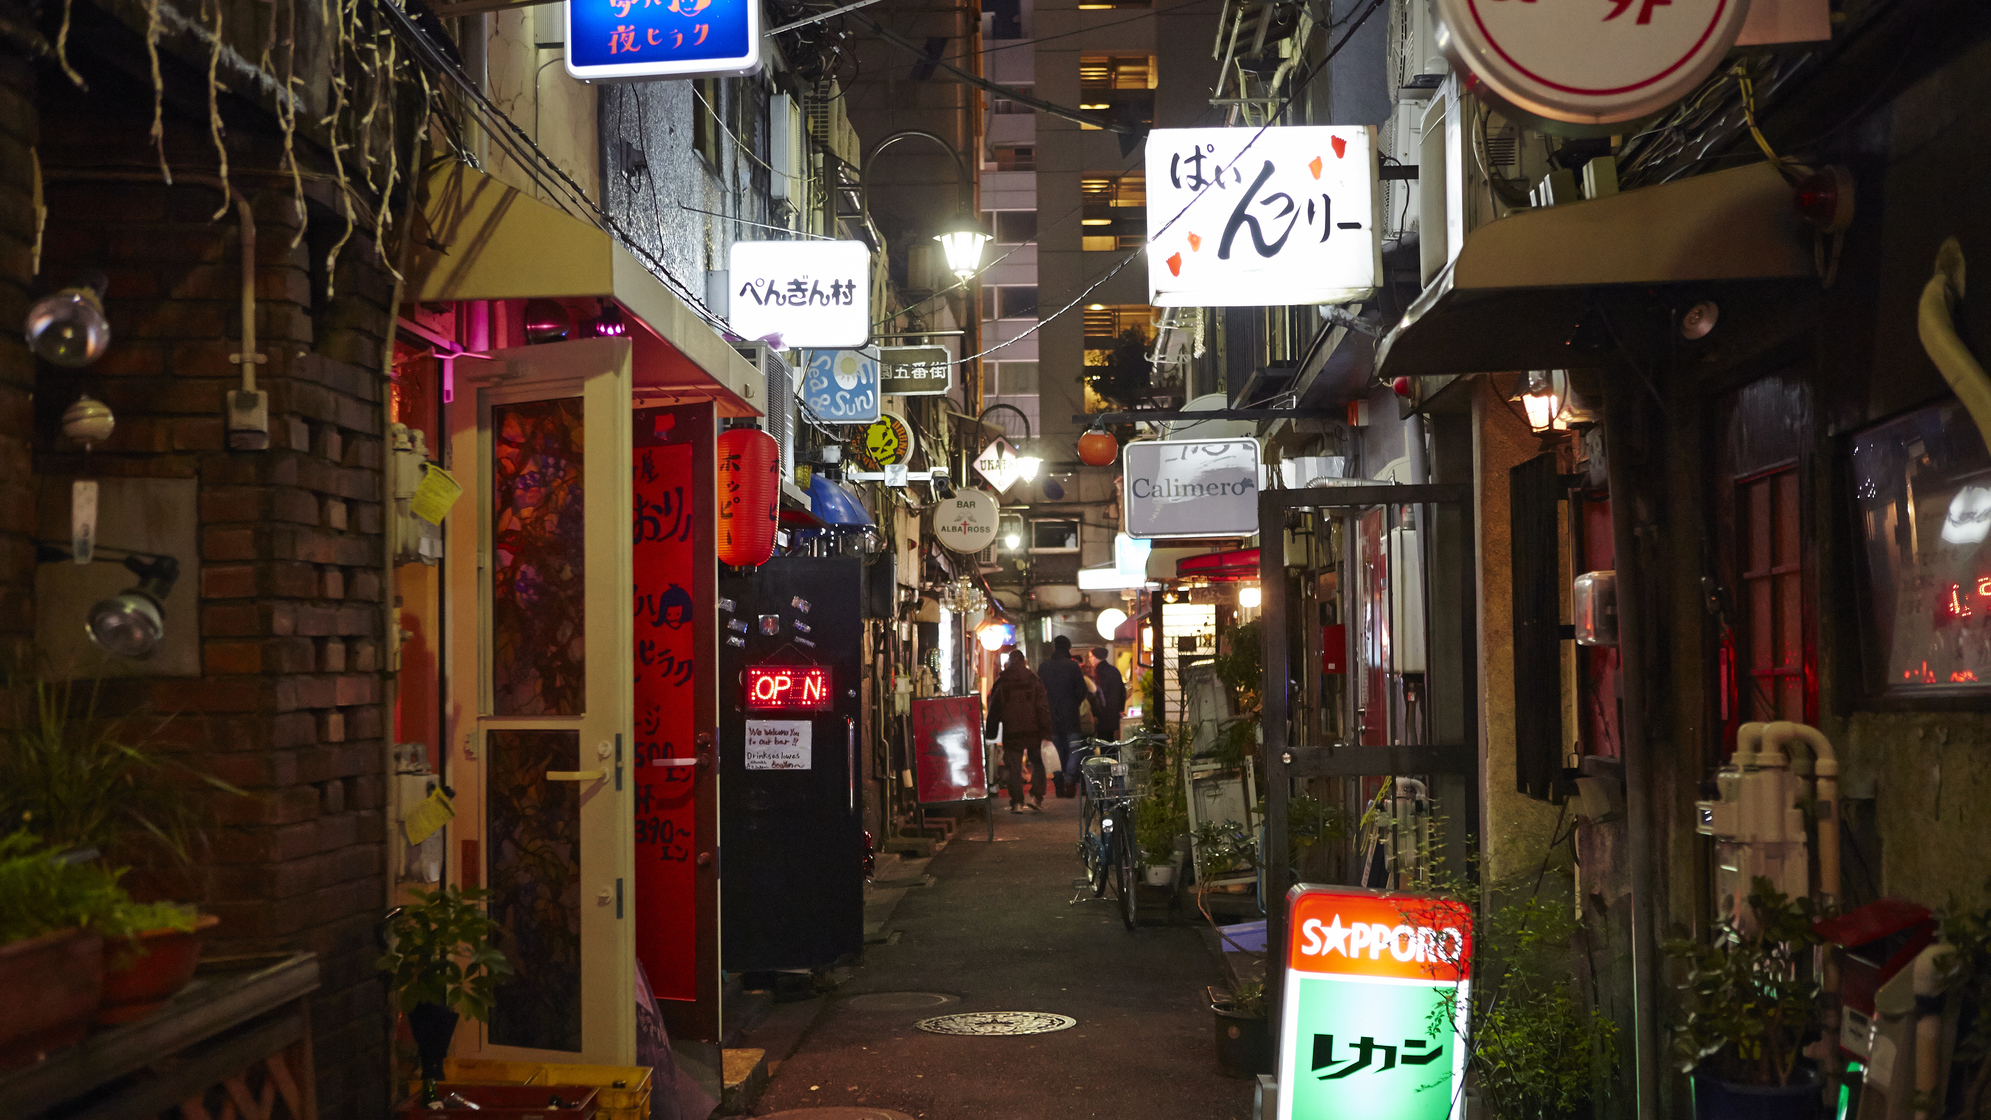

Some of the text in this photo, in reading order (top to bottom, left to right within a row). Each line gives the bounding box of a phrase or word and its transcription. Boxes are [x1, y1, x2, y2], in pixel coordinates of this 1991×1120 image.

[608, 23, 709, 55] 夜ヒラク
[739, 274, 857, 307] ぺんぎん村
[808, 355, 832, 394] Sea
[830, 389, 874, 416] Sun
[720, 452, 741, 546] ホッピー
[1132, 477, 1246, 499] Calimero
[956, 501, 976, 509] BAR
[941, 521, 990, 535] ALBATROSS
[756, 676, 822, 700] OPEN
[921, 702, 974, 726] BAR
[774, 737, 790, 745] bar
